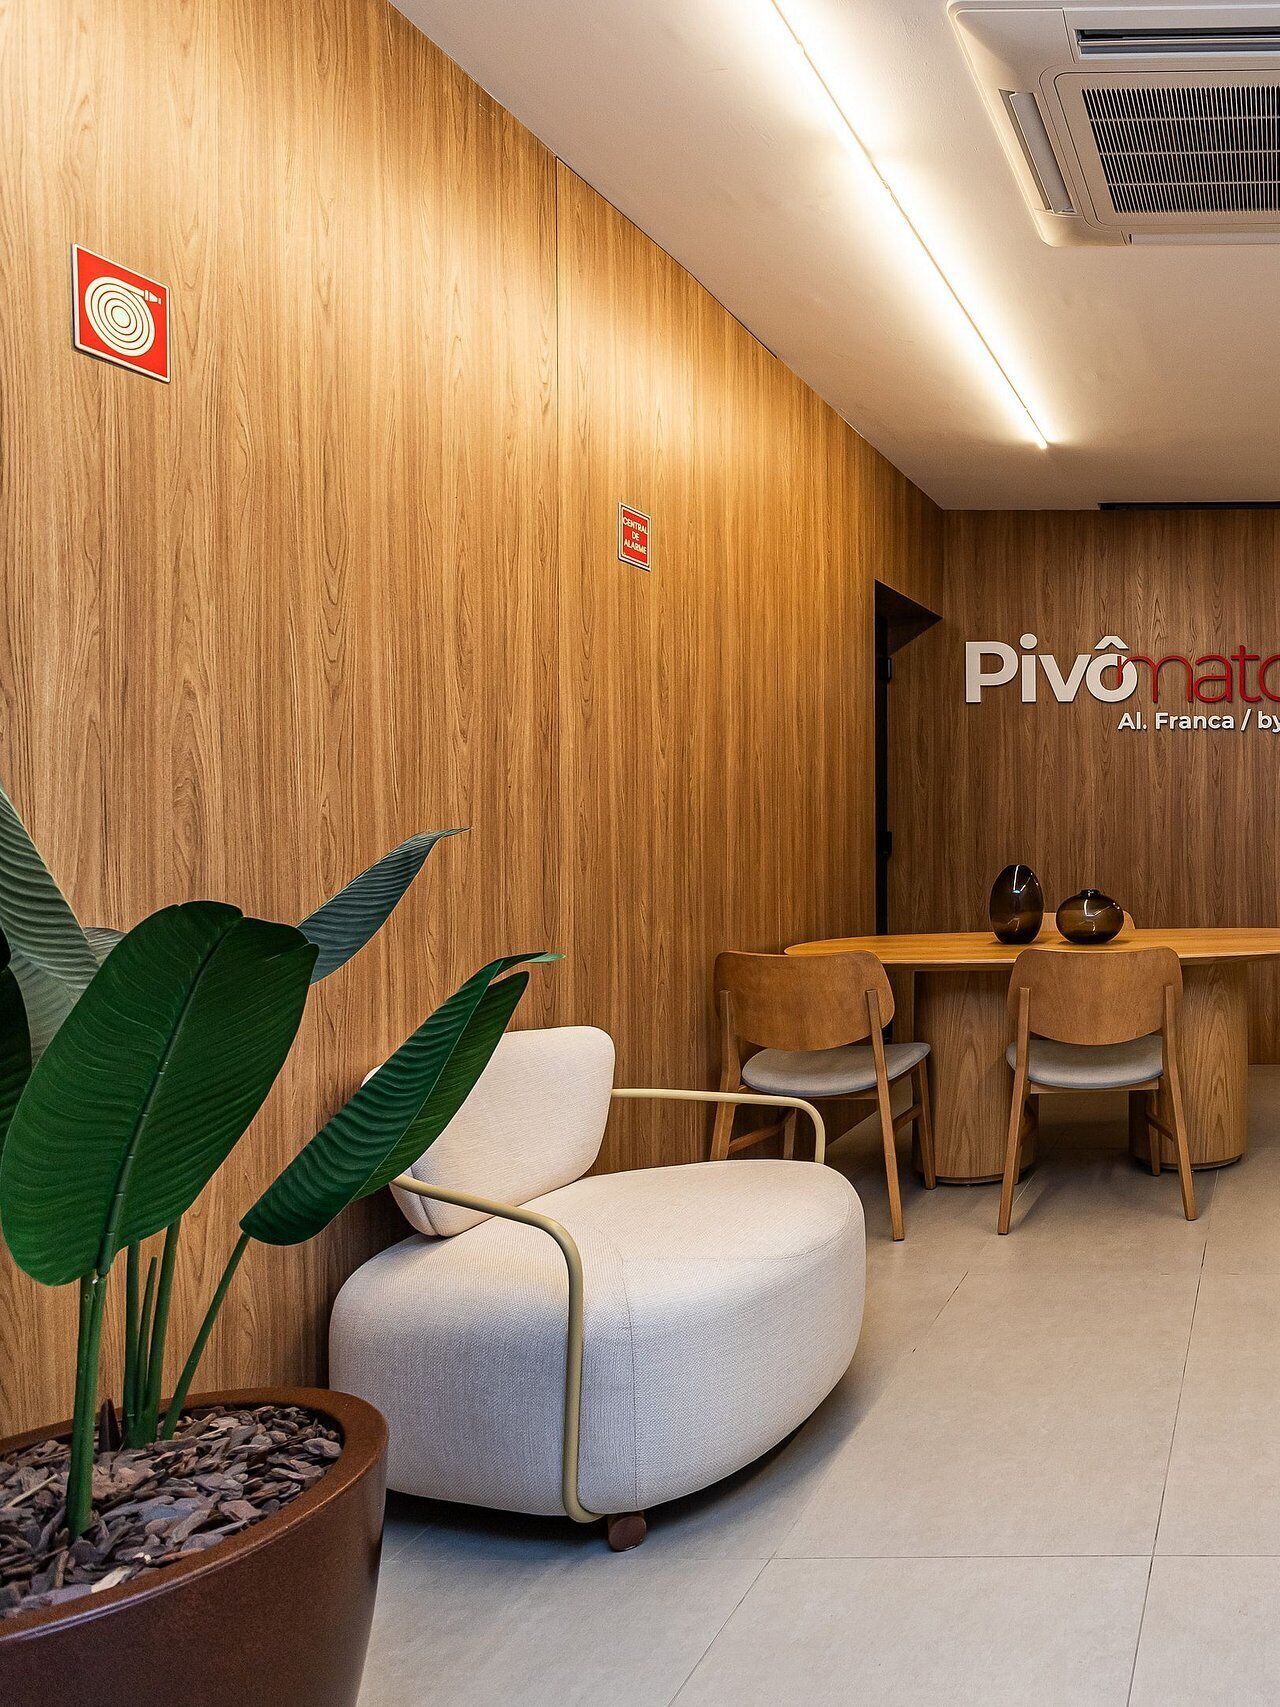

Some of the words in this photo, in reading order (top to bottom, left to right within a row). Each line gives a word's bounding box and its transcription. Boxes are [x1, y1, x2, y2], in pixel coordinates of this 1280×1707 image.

[622, 517, 648, 535] CENTRAL
[631, 531, 640, 541] DE
[624, 539, 647, 554] ALARME
[1117, 711, 1147, 731] Al.
[1155, 712, 1235, 731] Franca
[1240, 709, 1252, 731] /
